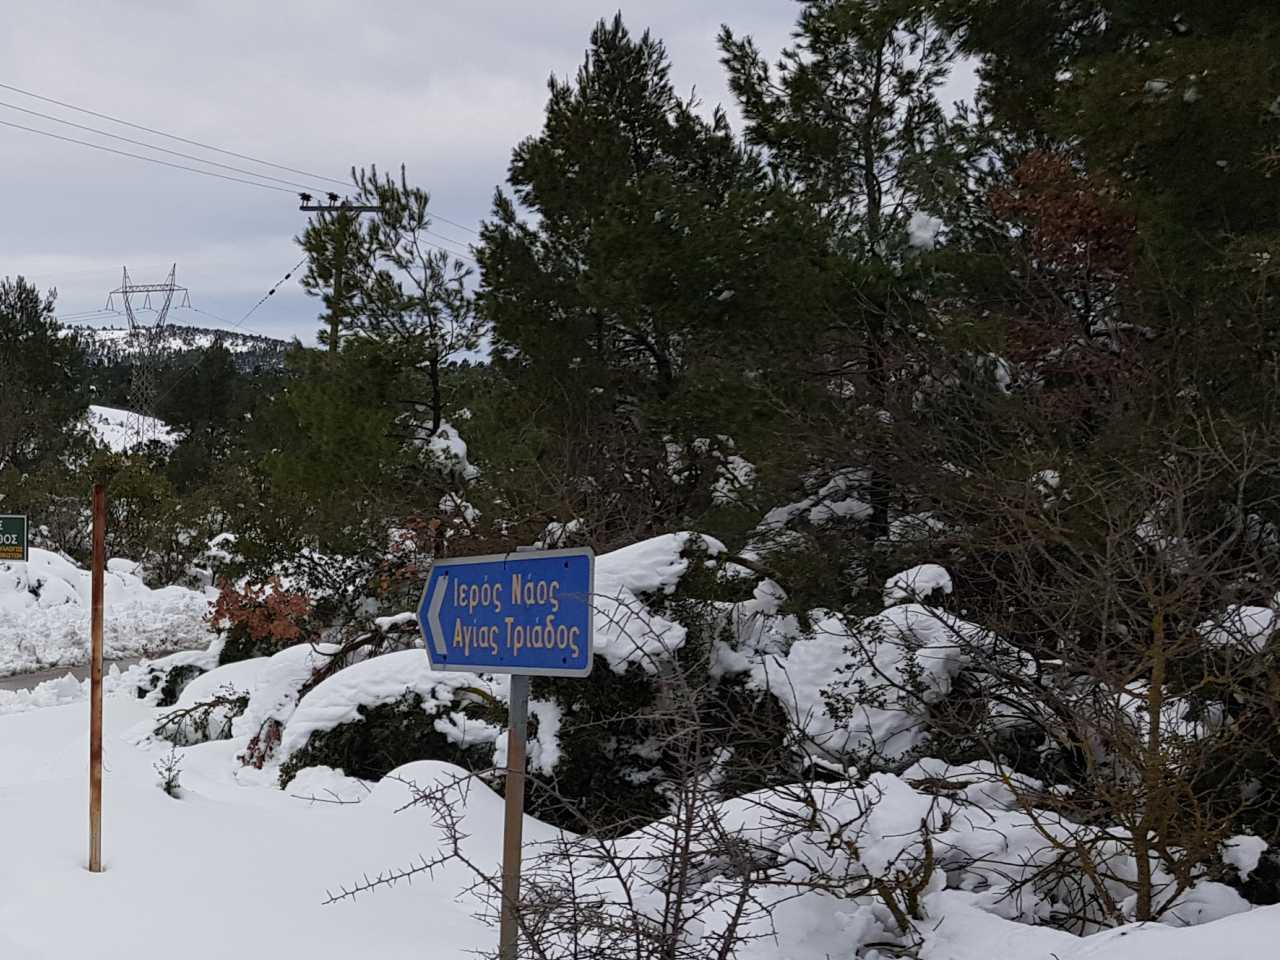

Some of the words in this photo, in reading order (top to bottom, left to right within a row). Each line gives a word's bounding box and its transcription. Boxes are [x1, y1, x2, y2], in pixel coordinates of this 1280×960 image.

[454, 575, 503, 613] Ιερός
[512, 573, 559, 612] Νάος
[453, 618, 499, 657] Αγίας
[505, 614, 580, 658] Τριάδος
